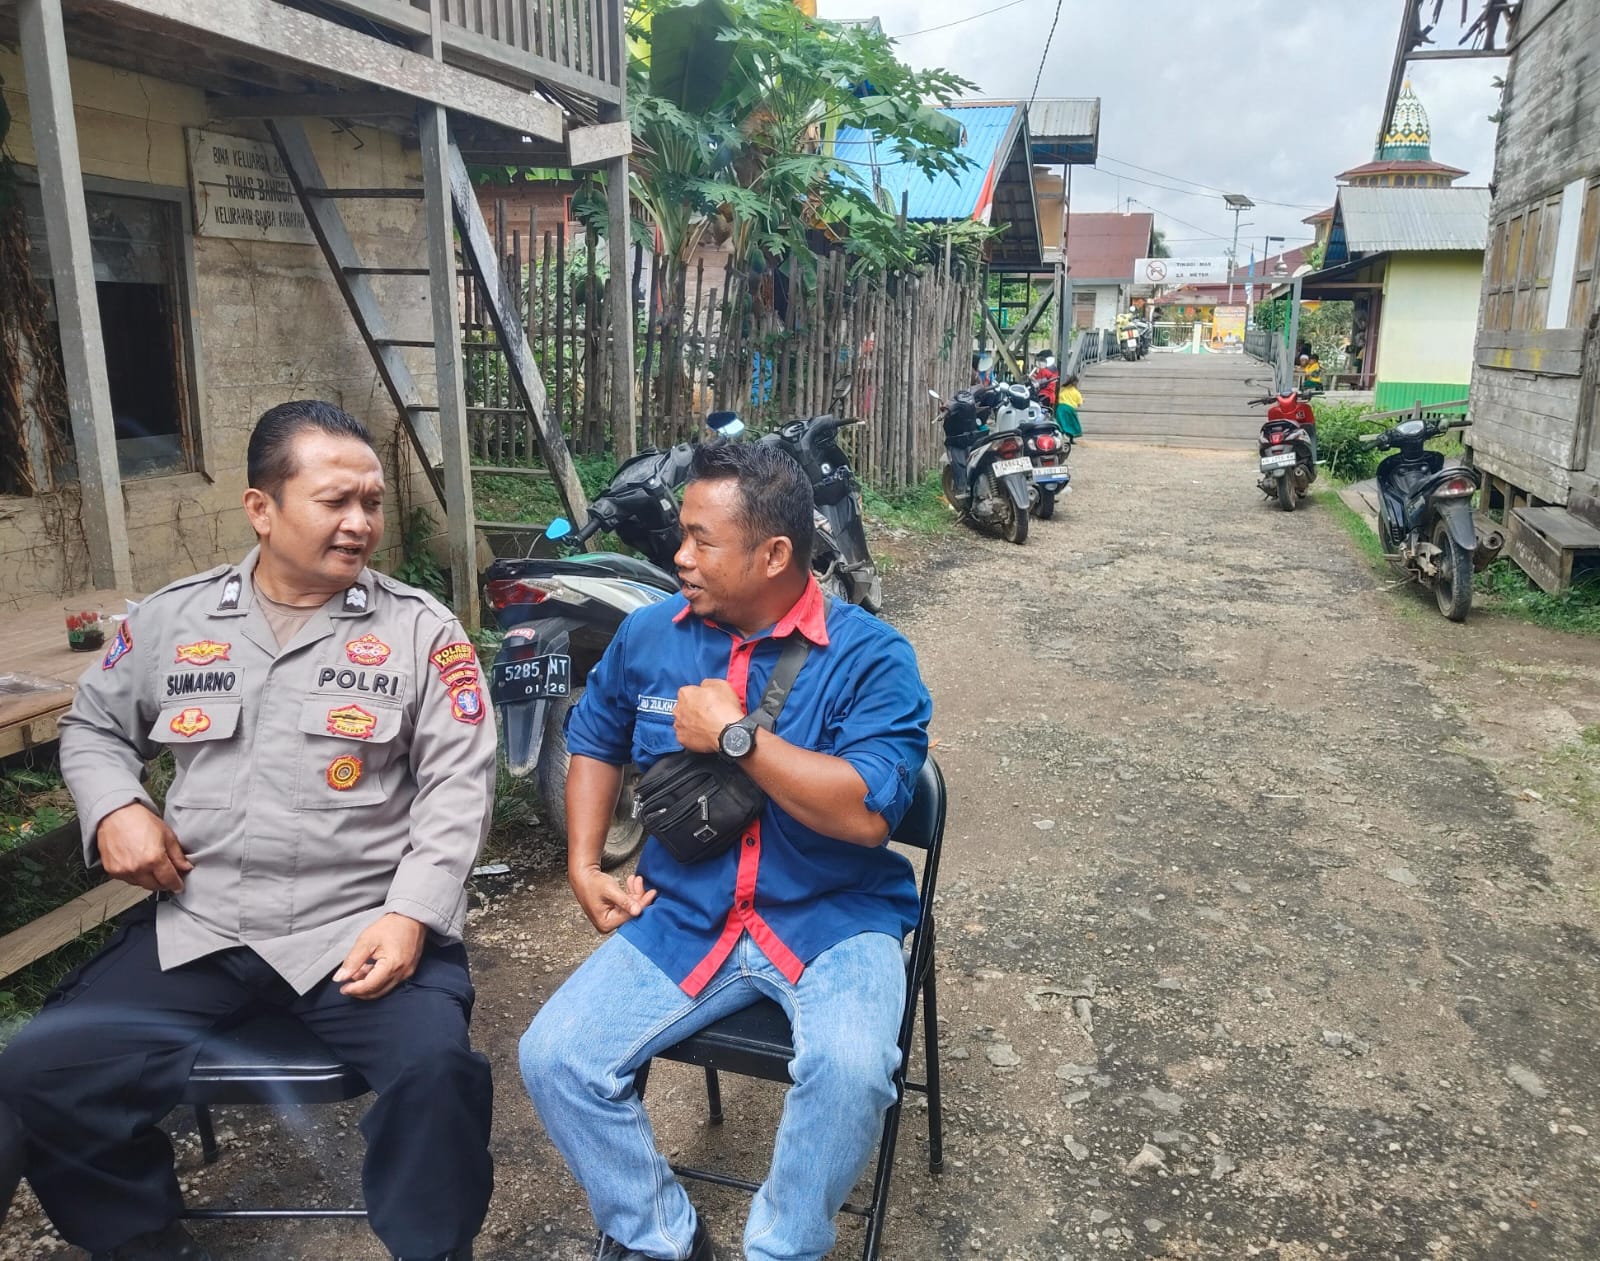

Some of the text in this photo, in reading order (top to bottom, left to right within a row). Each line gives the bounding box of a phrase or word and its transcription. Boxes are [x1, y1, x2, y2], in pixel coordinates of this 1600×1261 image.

[225, 174, 255, 201] TUNAS
[318, 667, 399, 697] POLRI
[505, 658, 567, 681] 5285 NT
[167, 671, 236, 697] SUMARNO
[549, 682, 567, 694] 26
